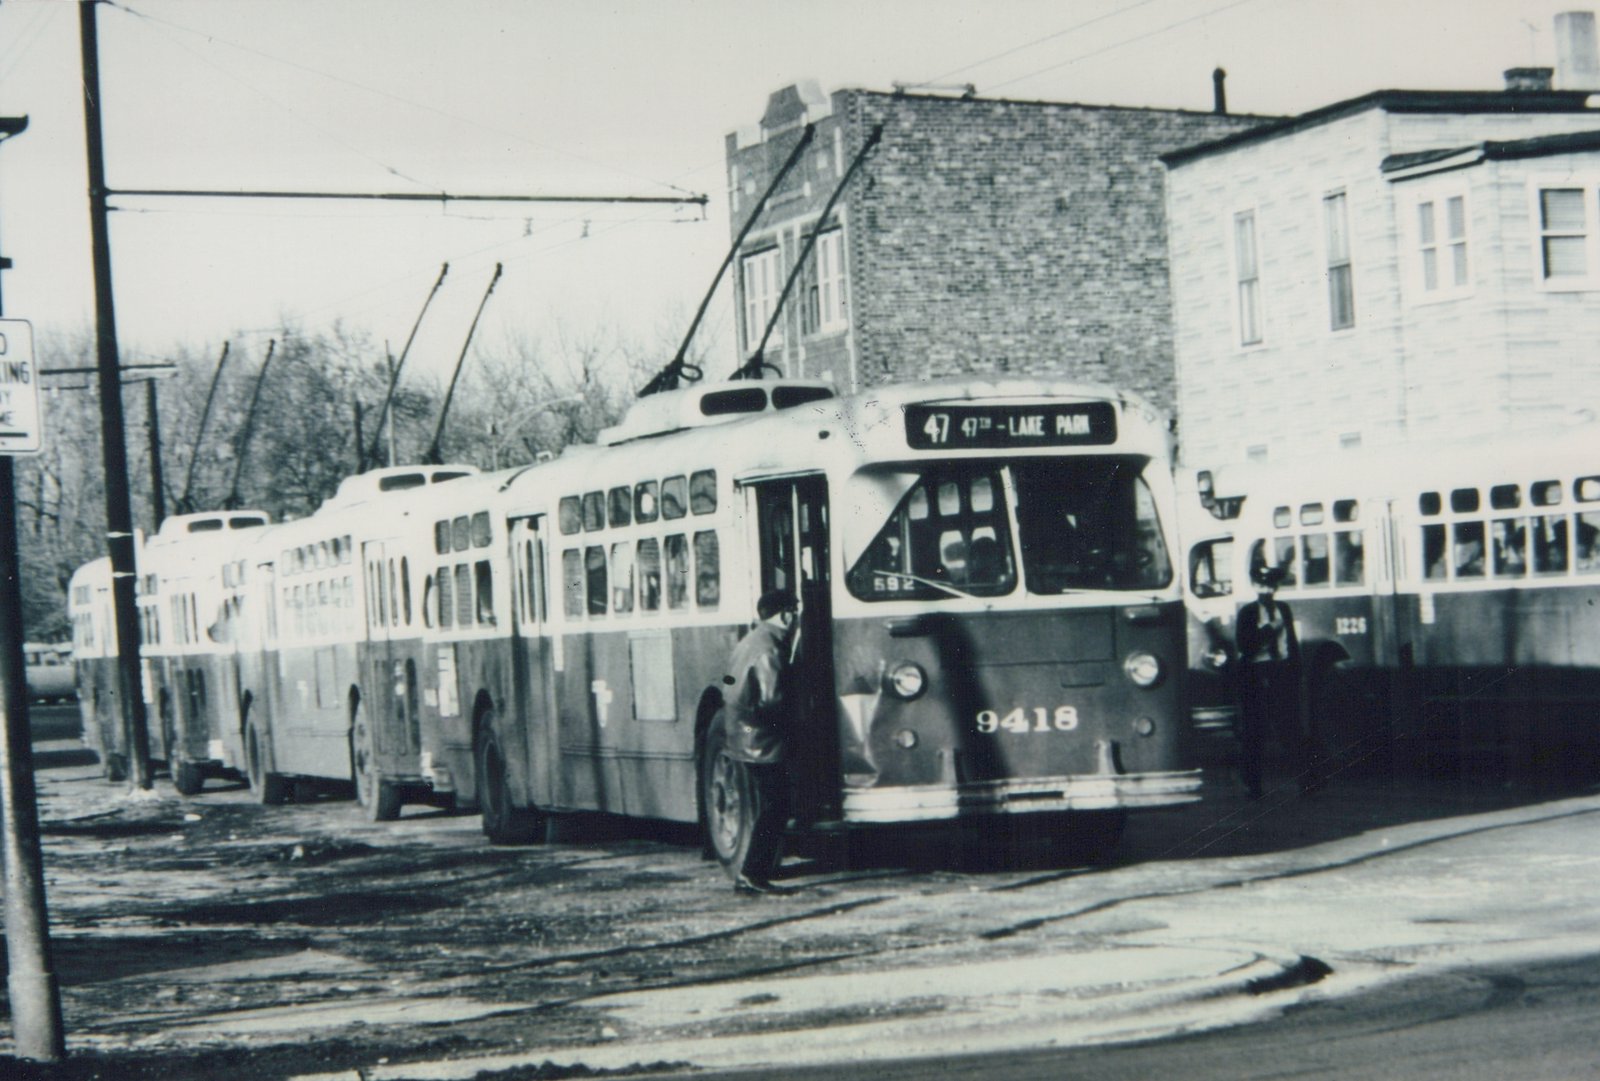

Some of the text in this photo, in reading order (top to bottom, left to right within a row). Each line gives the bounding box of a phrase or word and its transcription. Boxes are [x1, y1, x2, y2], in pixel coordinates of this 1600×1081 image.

[924, 413, 949, 443] 47
[1009, 415, 1045, 437] LAKE
[1056, 414, 1091, 435] PARK
[976, 706, 1078, 733] 9418
